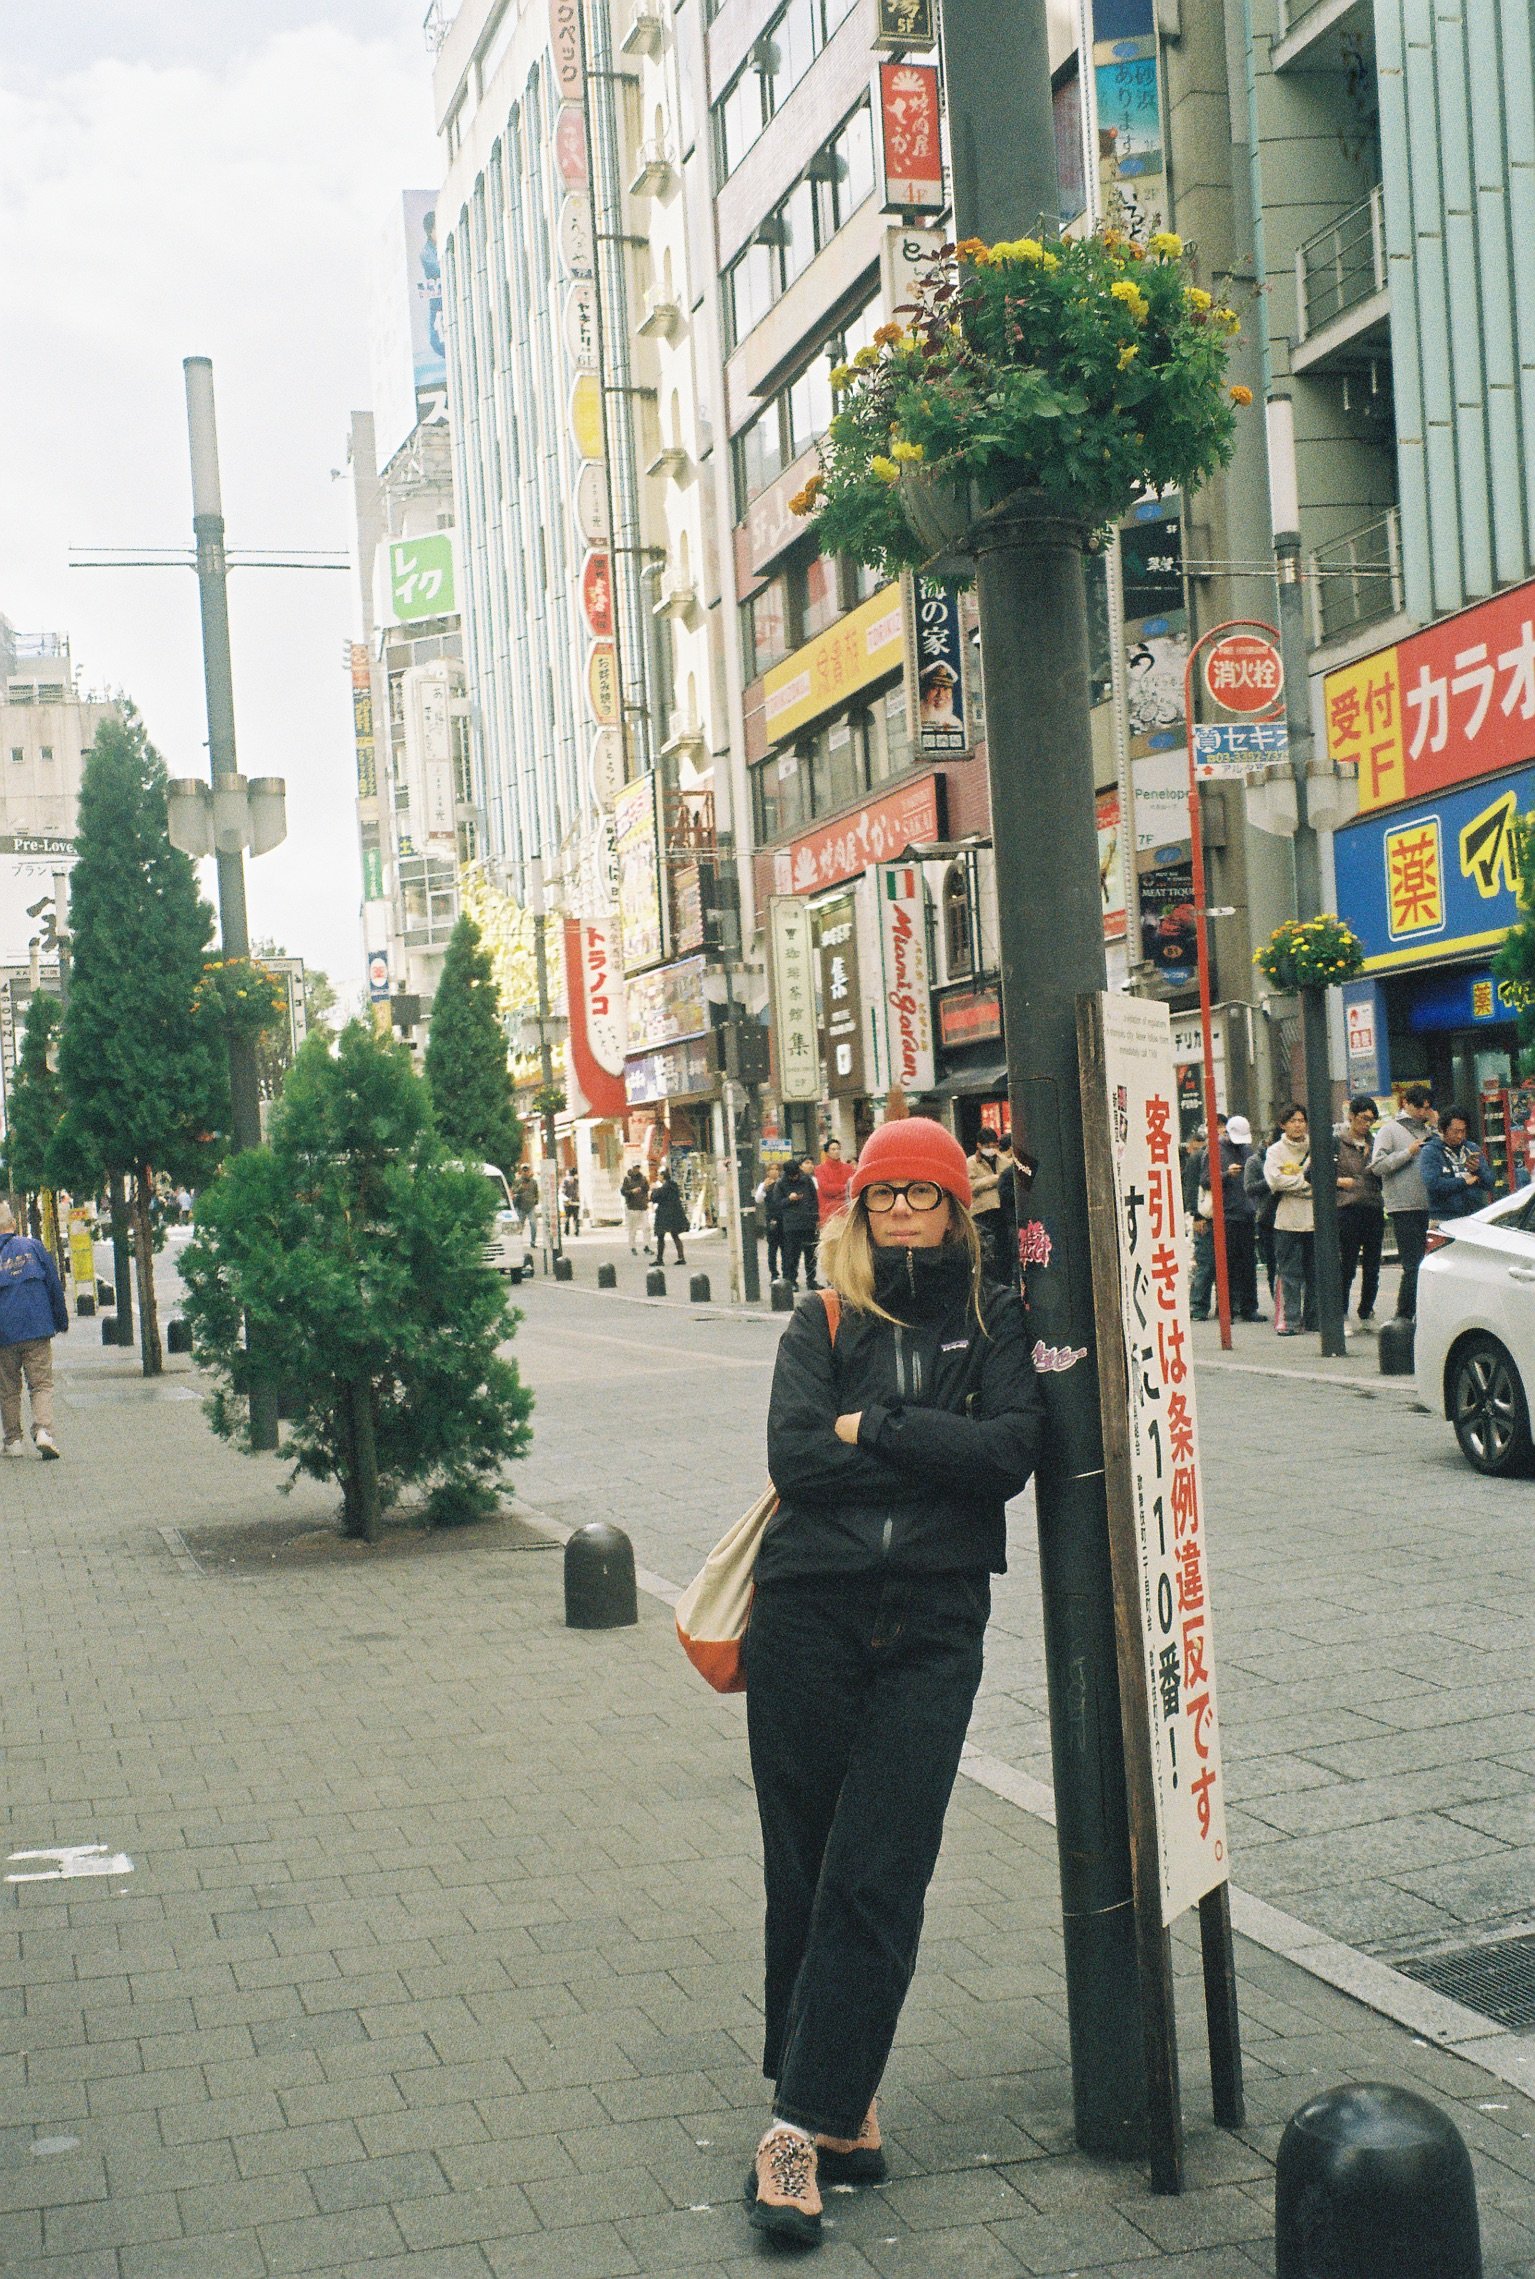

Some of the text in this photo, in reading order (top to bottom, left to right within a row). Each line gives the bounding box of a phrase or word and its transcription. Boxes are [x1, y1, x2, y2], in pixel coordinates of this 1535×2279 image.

[886, 98, 912, 173] さかい
[394, 547, 443, 604] レイク
[1213, 659, 1276, 689] 消火栓
[1331, 671, 1396, 749] 受付
[1338, 738, 1396, 798] F
[1138, 834, 1154, 845] 7F
[1392, 831, 1438, 928] 薬
[586, 927, 609, 1016] トラノコ
[889, 903, 920, 1087] Miami Garden
[1474, 983, 1493, 1015] 薬
[1124, 1185, 1181, 1789] すぐに110番!
[1144, 1093, 1223, 1861] 客引きは条例違反です。
